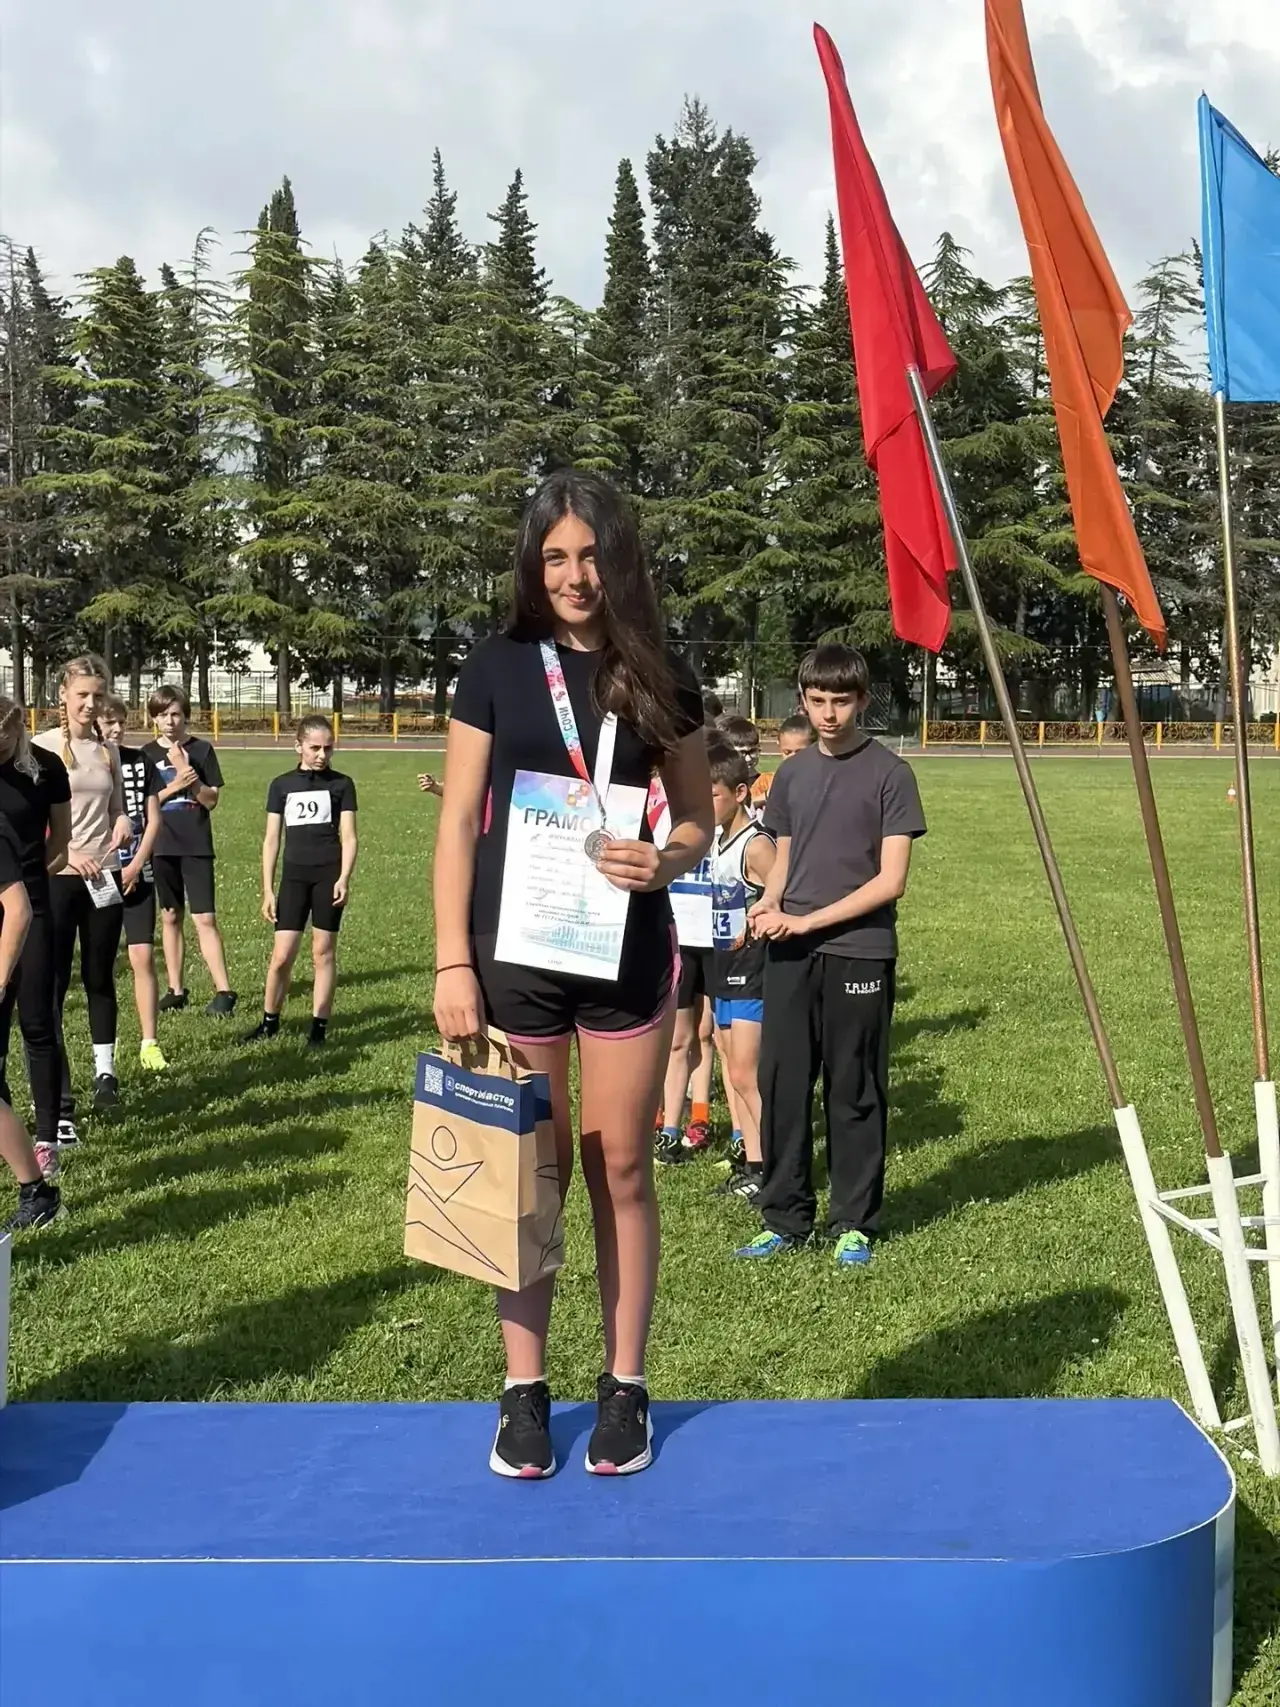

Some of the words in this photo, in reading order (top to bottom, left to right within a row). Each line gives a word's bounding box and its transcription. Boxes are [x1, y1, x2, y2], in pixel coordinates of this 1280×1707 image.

[558, 706, 573, 732] СОЧИ
[296, 801, 319, 819] 29
[844, 979, 881, 991] TRUST
